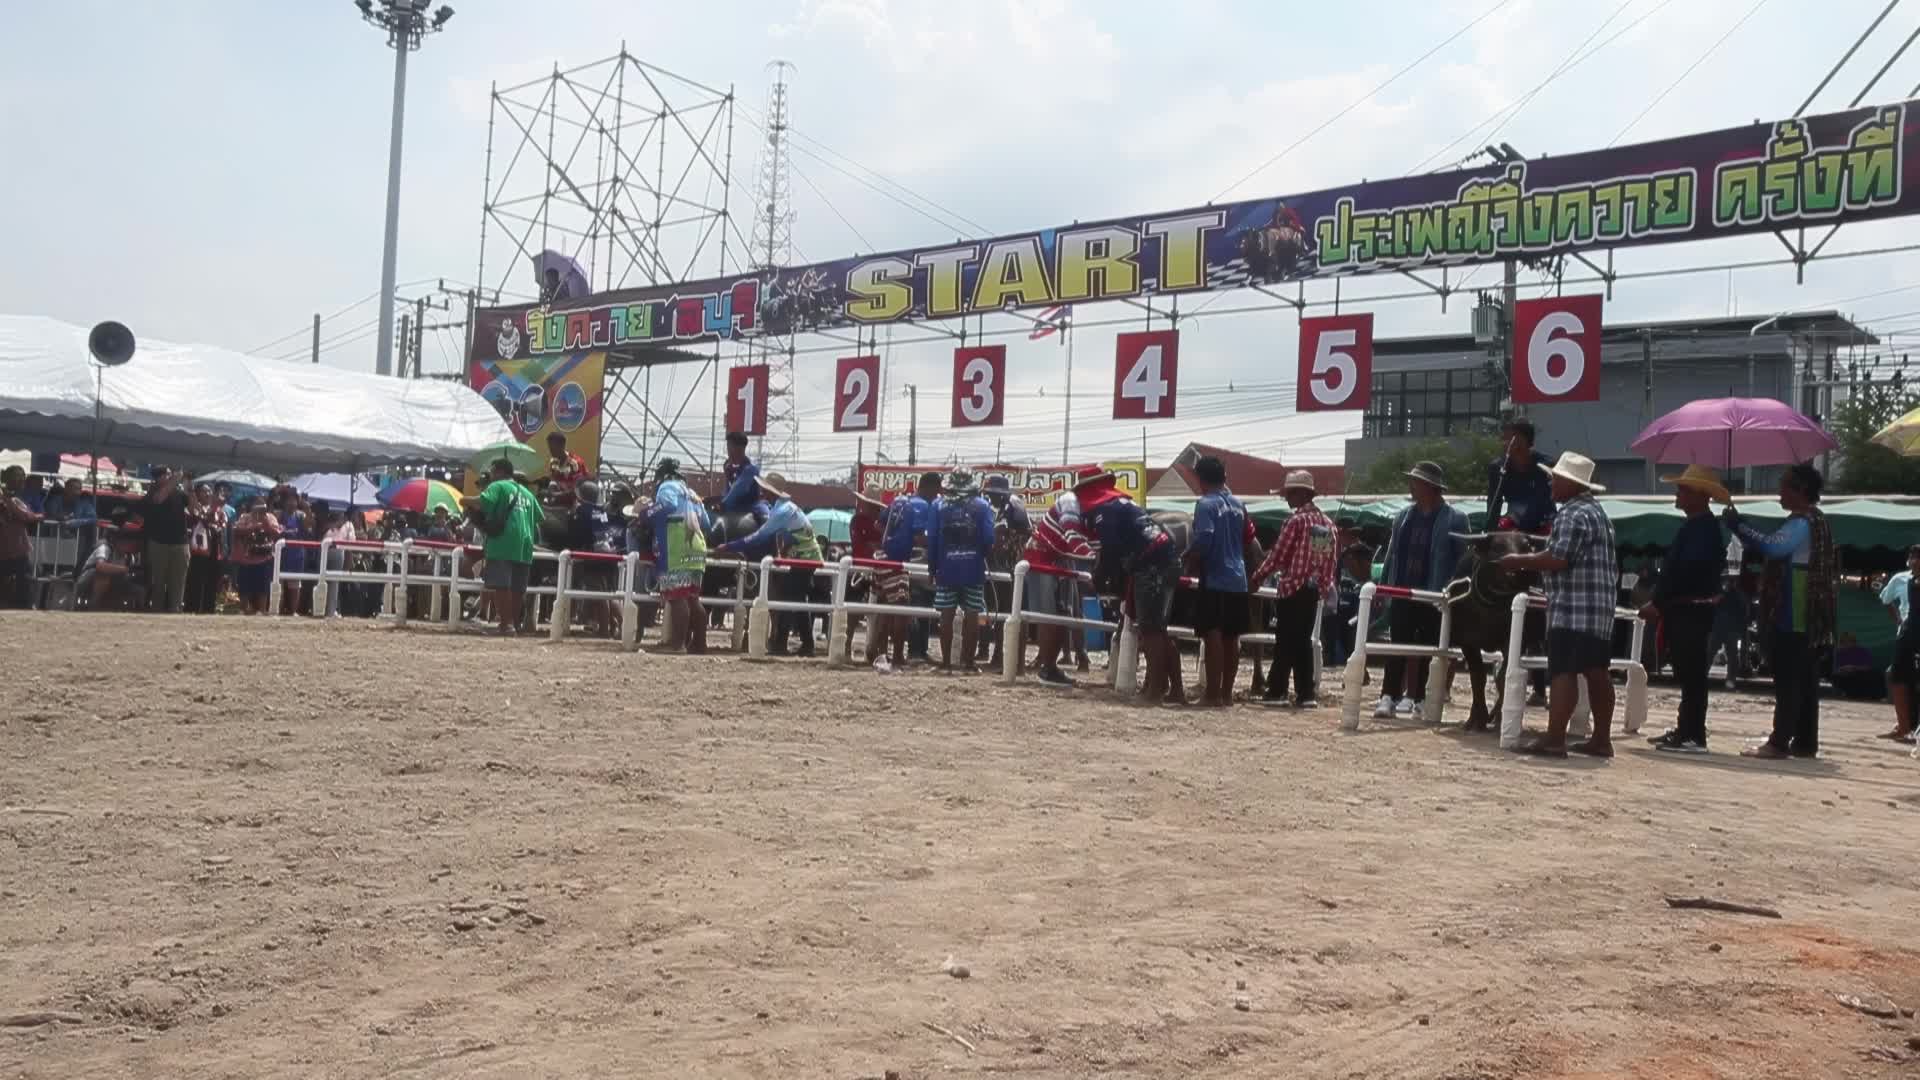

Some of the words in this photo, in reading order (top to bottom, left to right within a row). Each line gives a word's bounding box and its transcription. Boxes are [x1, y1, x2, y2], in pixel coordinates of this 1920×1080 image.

[1315, 162, 1697, 268] ประเพณีวิ่งควาย
[1712, 103, 1907, 228] ครั้งที่
[845, 210, 1226, 324] START
[960, 357, 994, 423] 3
[1121, 345, 1168, 414] 4
[1309, 329, 1357, 406] 5
[1527, 311, 1585, 396] 6
[737, 377, 754, 433] 1
[840, 367, 870, 428] 2
